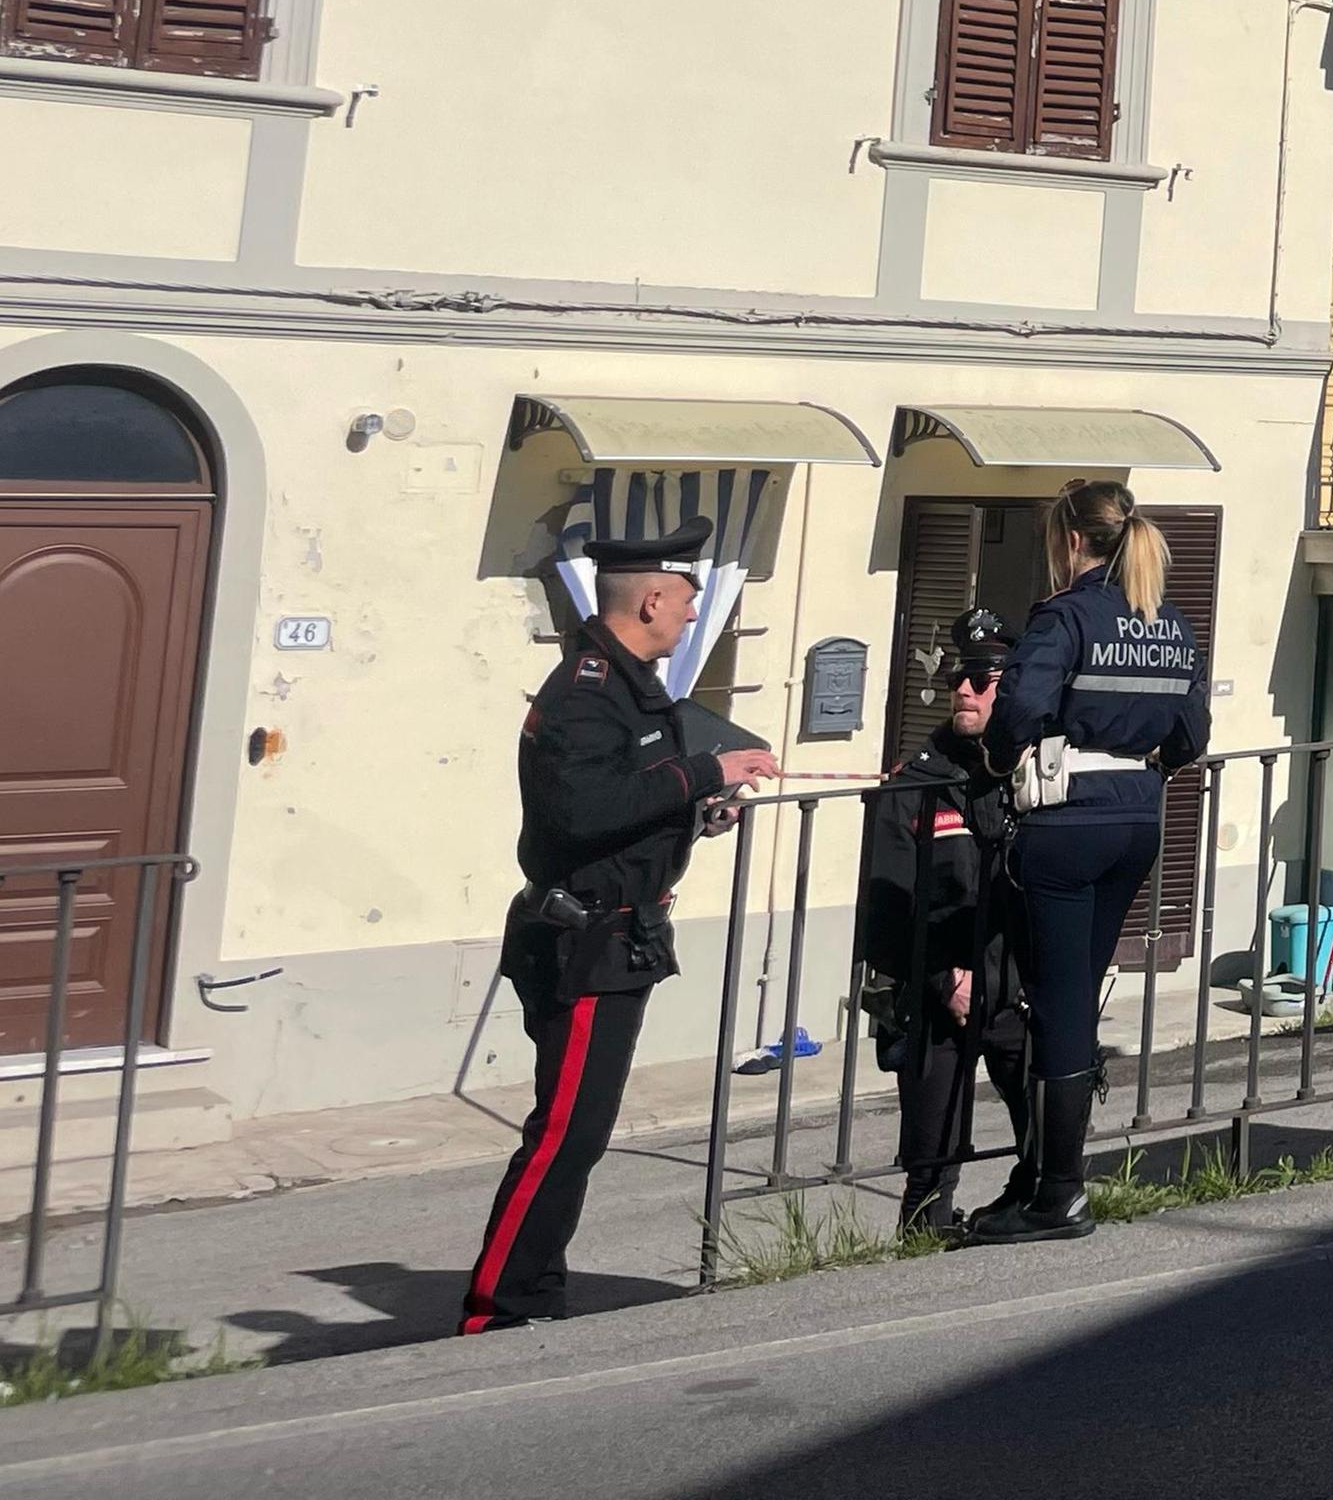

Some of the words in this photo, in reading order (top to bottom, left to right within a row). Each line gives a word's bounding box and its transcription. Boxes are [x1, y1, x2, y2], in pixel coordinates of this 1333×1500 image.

[288, 622, 317, 643] 46
[1116, 616, 1183, 641] POLIZIA
[1091, 642, 1195, 671] MUNICIPALE
